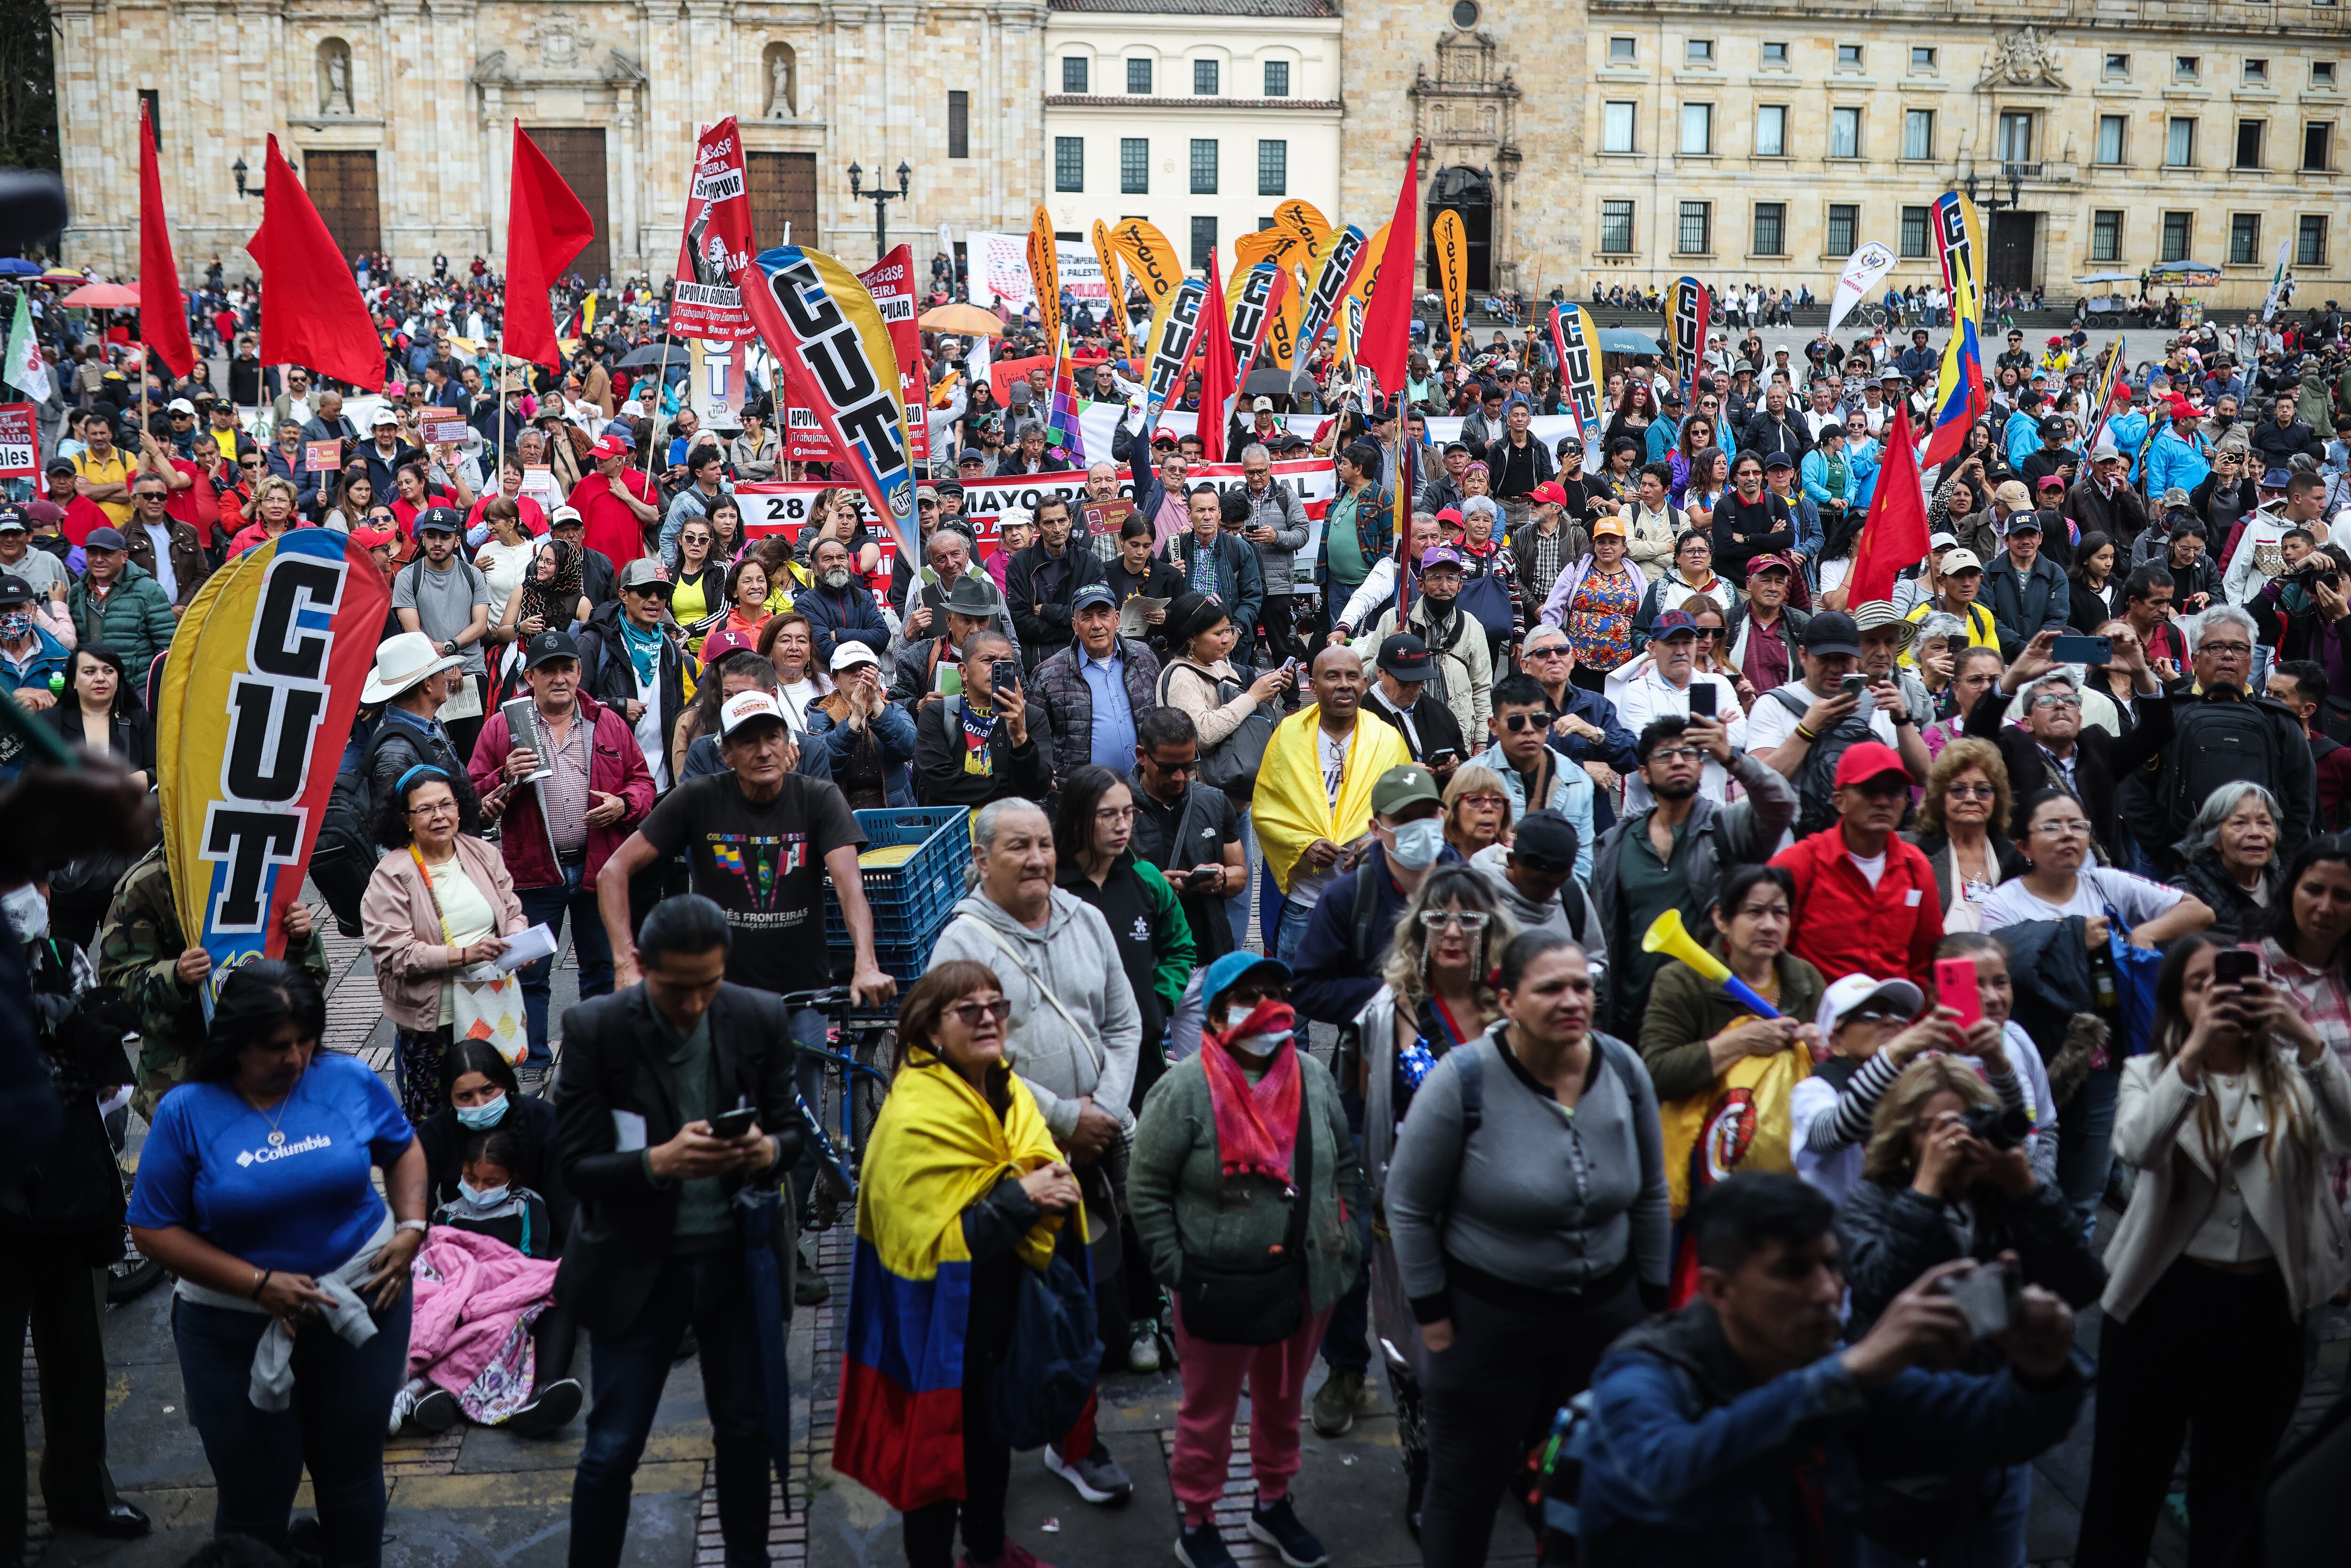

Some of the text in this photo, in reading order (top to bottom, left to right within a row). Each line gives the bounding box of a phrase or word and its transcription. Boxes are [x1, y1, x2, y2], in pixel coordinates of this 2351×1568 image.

[1040, 212, 1057, 328] fecode
[1130, 225, 1168, 295] feco
[1447, 217, 1460, 332] fecode
[678, 284, 699, 302] APOYO
[700, 287, 708, 303] AL
[1098, 224, 1128, 339] fecode
[1305, 231, 1360, 335] CUT
[706, 309, 720, 322] Duro
[879, 300, 910, 319] PULAR
[1151, 286, 1205, 396] CUT
[1675, 284, 1697, 382] CUT
[770, 260, 906, 477] CUT
[999, 372, 1026, 387] Unión
[1560, 312, 1597, 420] CUT
[0, 433, 32, 443] ALUD
[909, 428, 924, 439] ente!
[433, 509, 442, 521] LA
[767, 498, 805, 520] 28
[2016, 515, 2029, 524] CAT
[205, 557, 344, 929] CUT
[530, 726, 542, 745] pueblo
[536, 746, 545, 765] decida
[707, 833, 748, 842] COLOMBIA
[749, 836, 780, 844] BRASIL
[743, 907, 808, 922] FRONTEIRAS
[254, 1133, 332, 1163] Columbia
